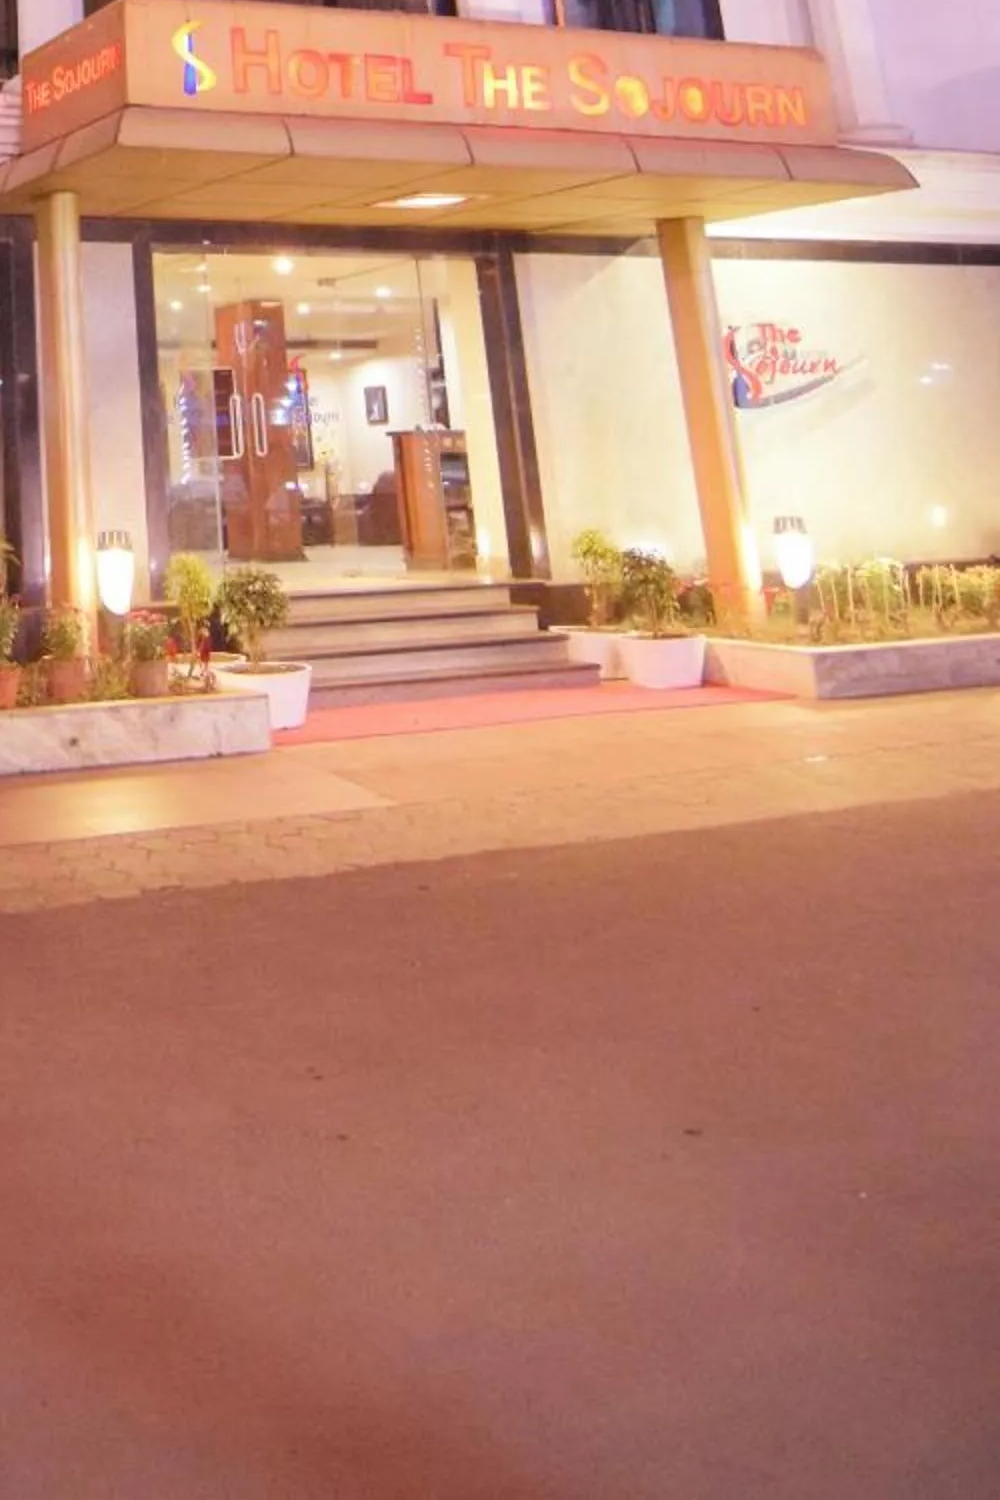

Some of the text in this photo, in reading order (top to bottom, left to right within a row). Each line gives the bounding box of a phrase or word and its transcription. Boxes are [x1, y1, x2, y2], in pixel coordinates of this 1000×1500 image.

[25, 42, 122, 114] THE SOJOURN
[230, 26, 434, 105] HOTEL
[443, 42, 551, 112] THE
[567, 51, 810, 127] SOJOURN
[755, 323, 802, 343] The
